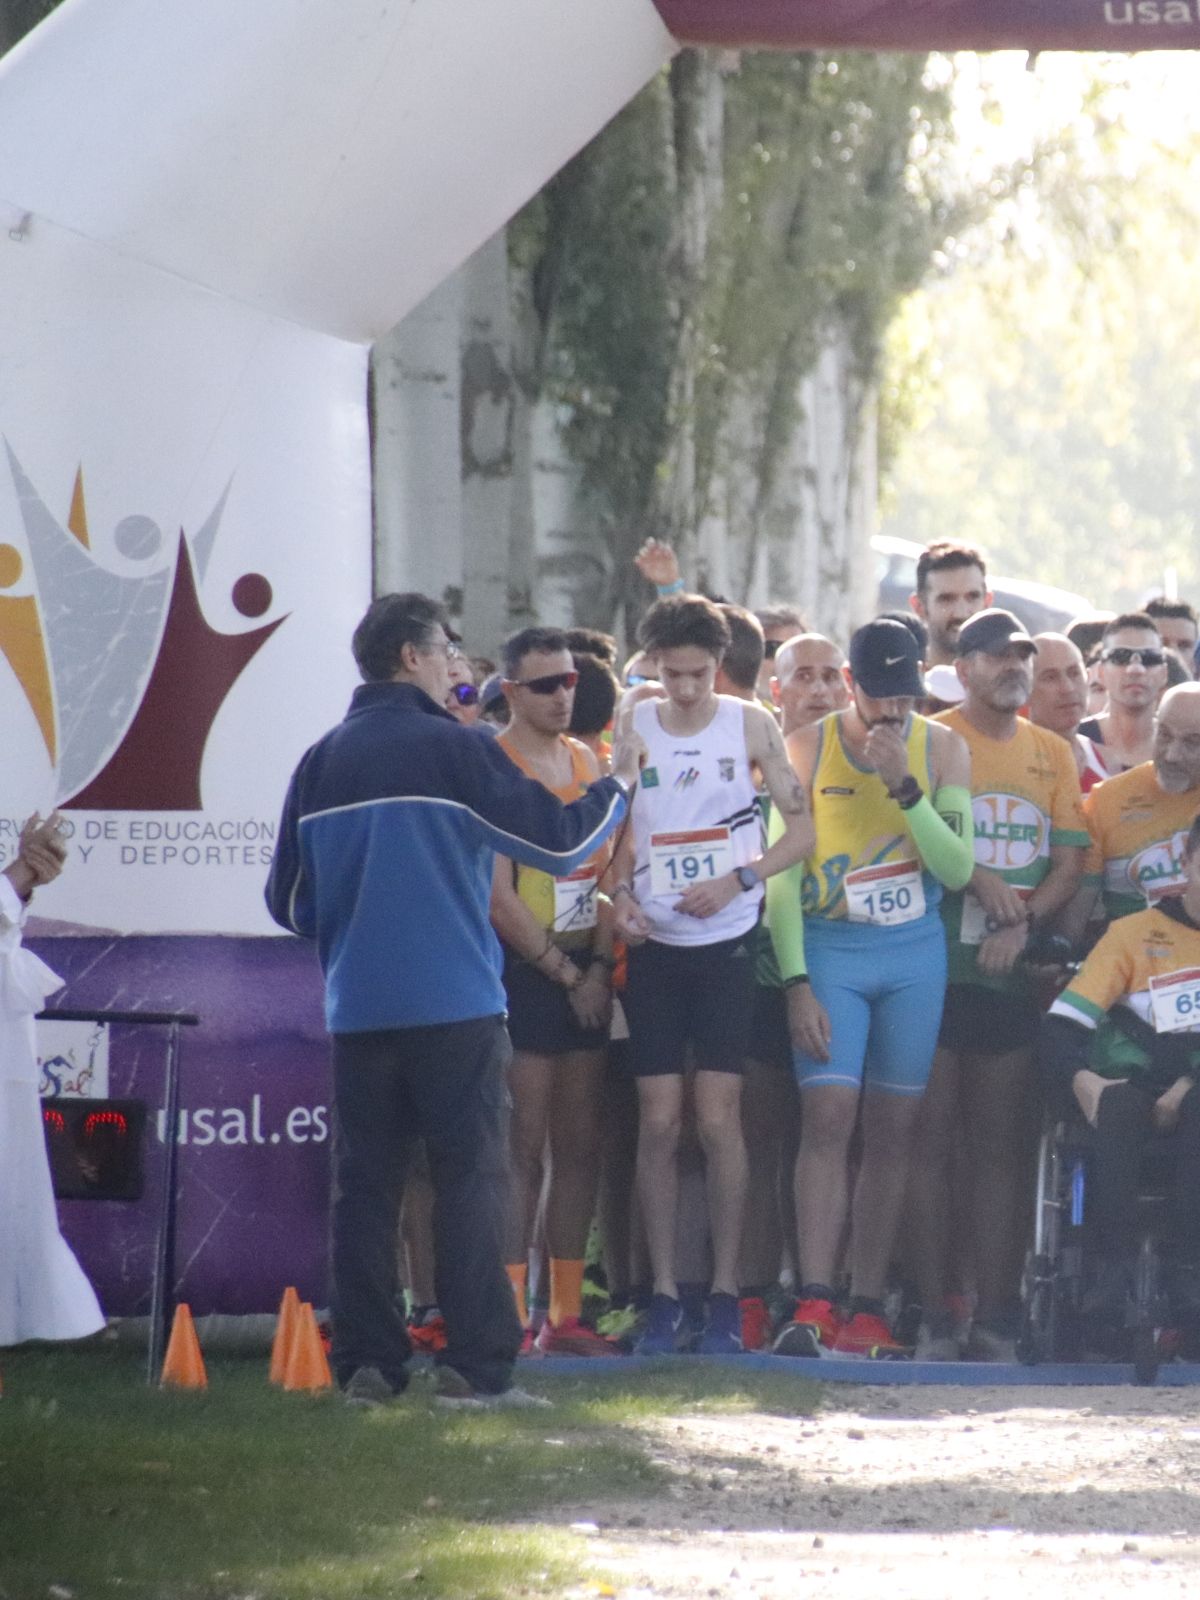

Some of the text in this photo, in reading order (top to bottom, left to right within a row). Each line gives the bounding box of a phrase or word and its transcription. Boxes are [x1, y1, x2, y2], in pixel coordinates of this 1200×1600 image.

[86, 820, 118, 840] DE
[129, 817, 275, 841] EDUCACIÓN
[79, 845, 273, 865] Y DEPORTES
[665, 854, 715, 880] 191
[864, 887, 912, 916] 150
[156, 1094, 328, 1145] usal.es
